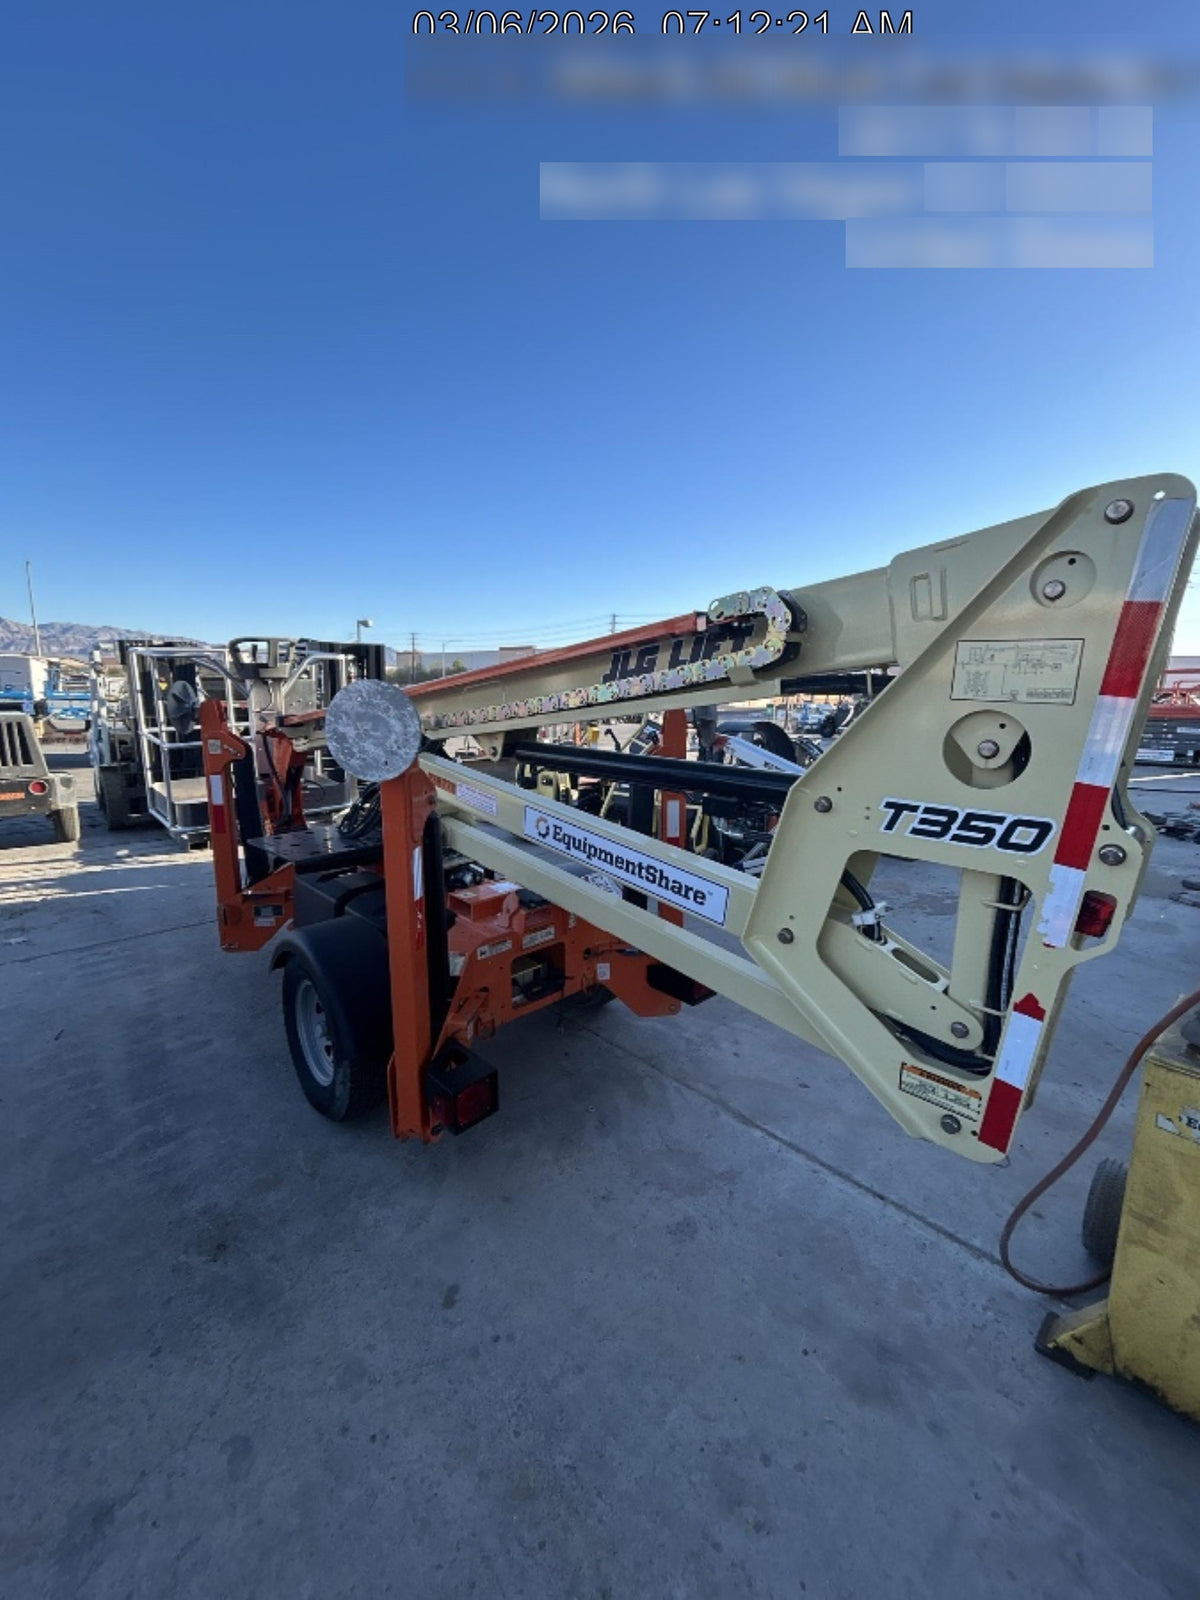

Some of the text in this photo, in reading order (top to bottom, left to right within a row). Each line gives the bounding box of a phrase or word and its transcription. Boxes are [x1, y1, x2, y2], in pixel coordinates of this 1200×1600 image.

[602, 643, 661, 683] JLG
[881, 800, 1055, 855] T350
[551, 823, 708, 907] EquipmentShare
